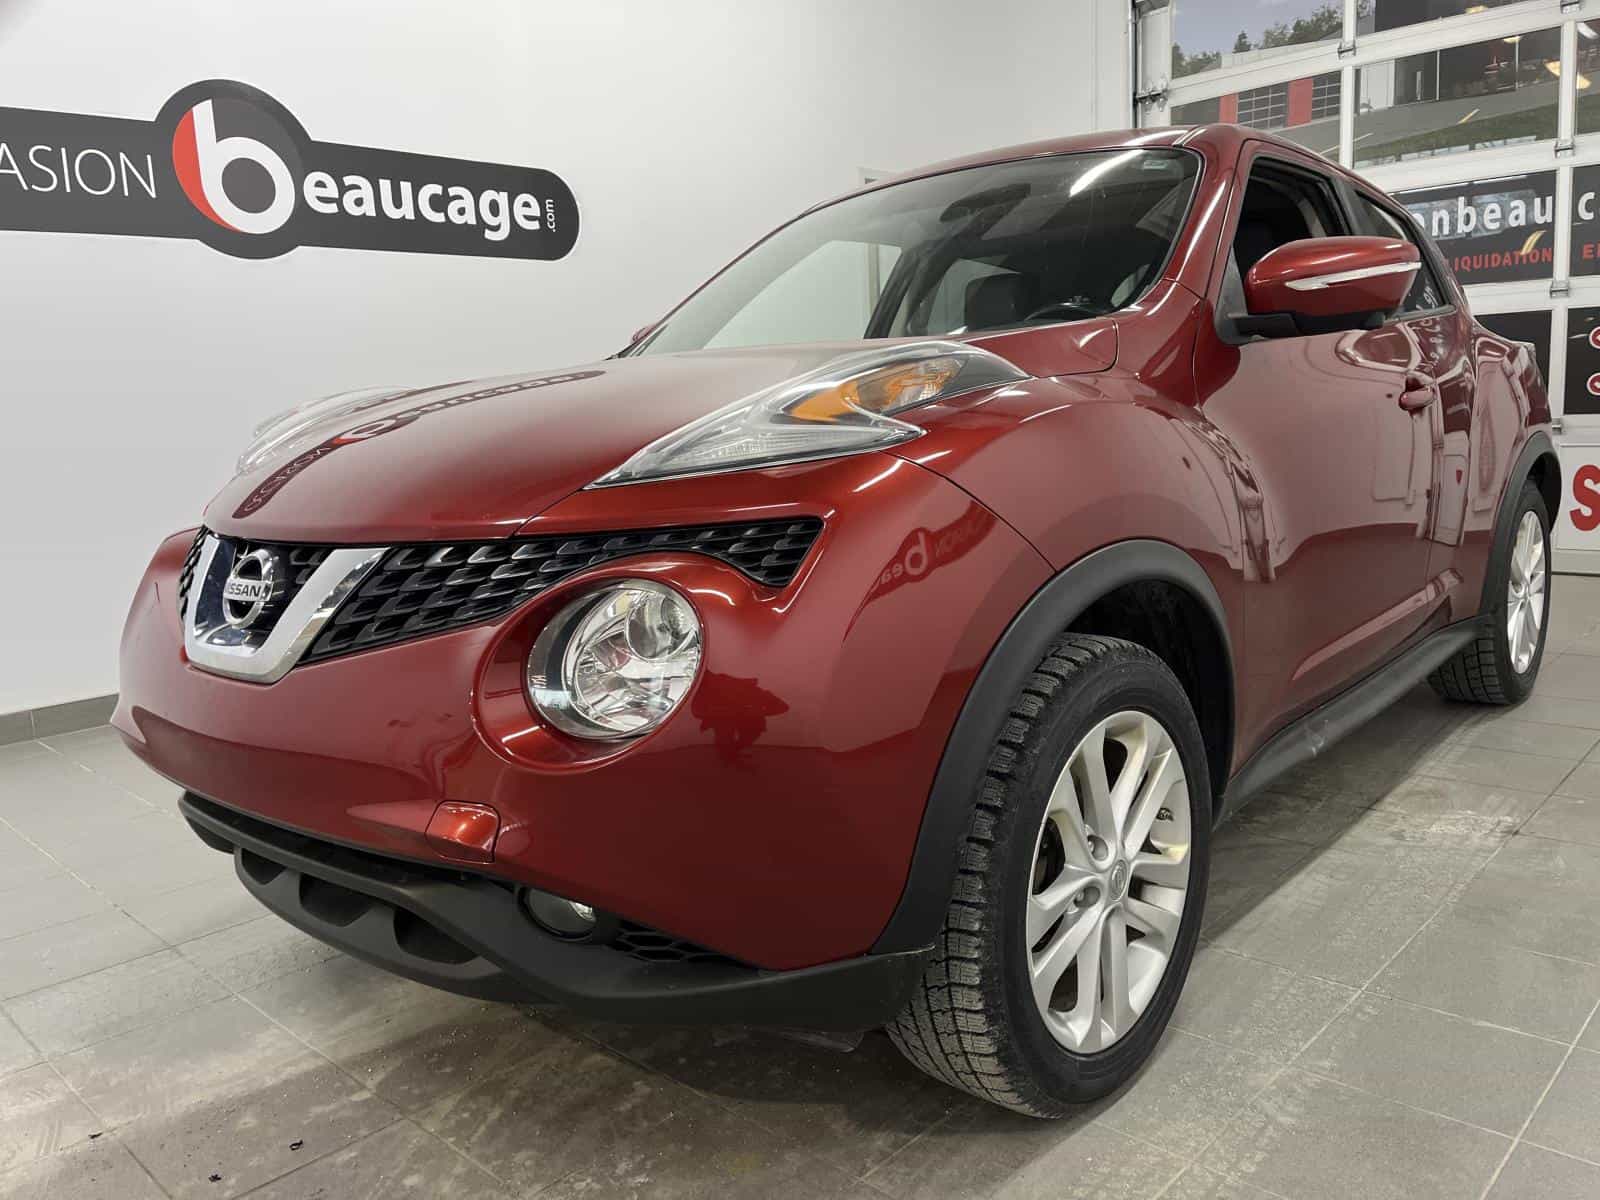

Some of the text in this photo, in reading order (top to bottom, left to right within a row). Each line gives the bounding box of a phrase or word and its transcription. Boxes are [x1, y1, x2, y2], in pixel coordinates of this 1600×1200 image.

[545, 199, 556, 233] .com
[1452, 247, 1553, 272] IQUIDATION
[225, 582, 262, 598] SSAN
